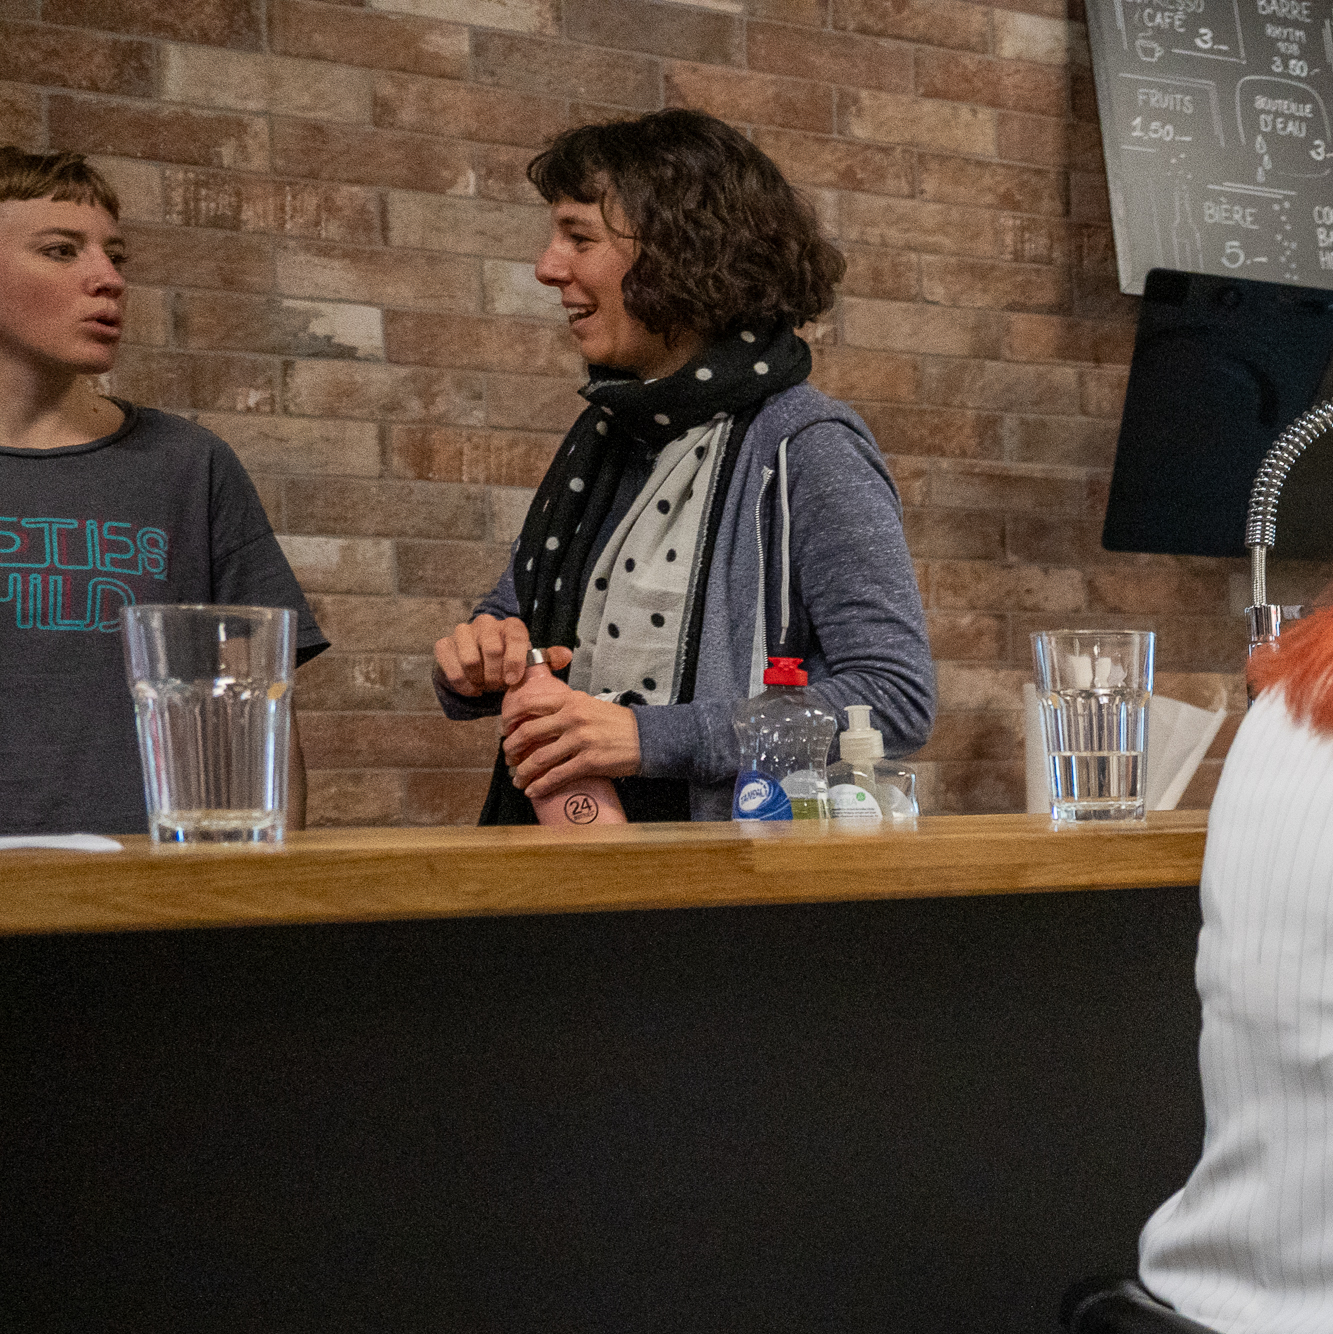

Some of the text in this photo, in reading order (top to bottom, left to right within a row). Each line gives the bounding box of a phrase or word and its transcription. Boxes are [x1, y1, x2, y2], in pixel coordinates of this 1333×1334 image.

[1143, 8, 1186, 32] CAFÉ
[1136, 88, 1194, 114] FRUITS
[570, 798, 592, 815] 24
